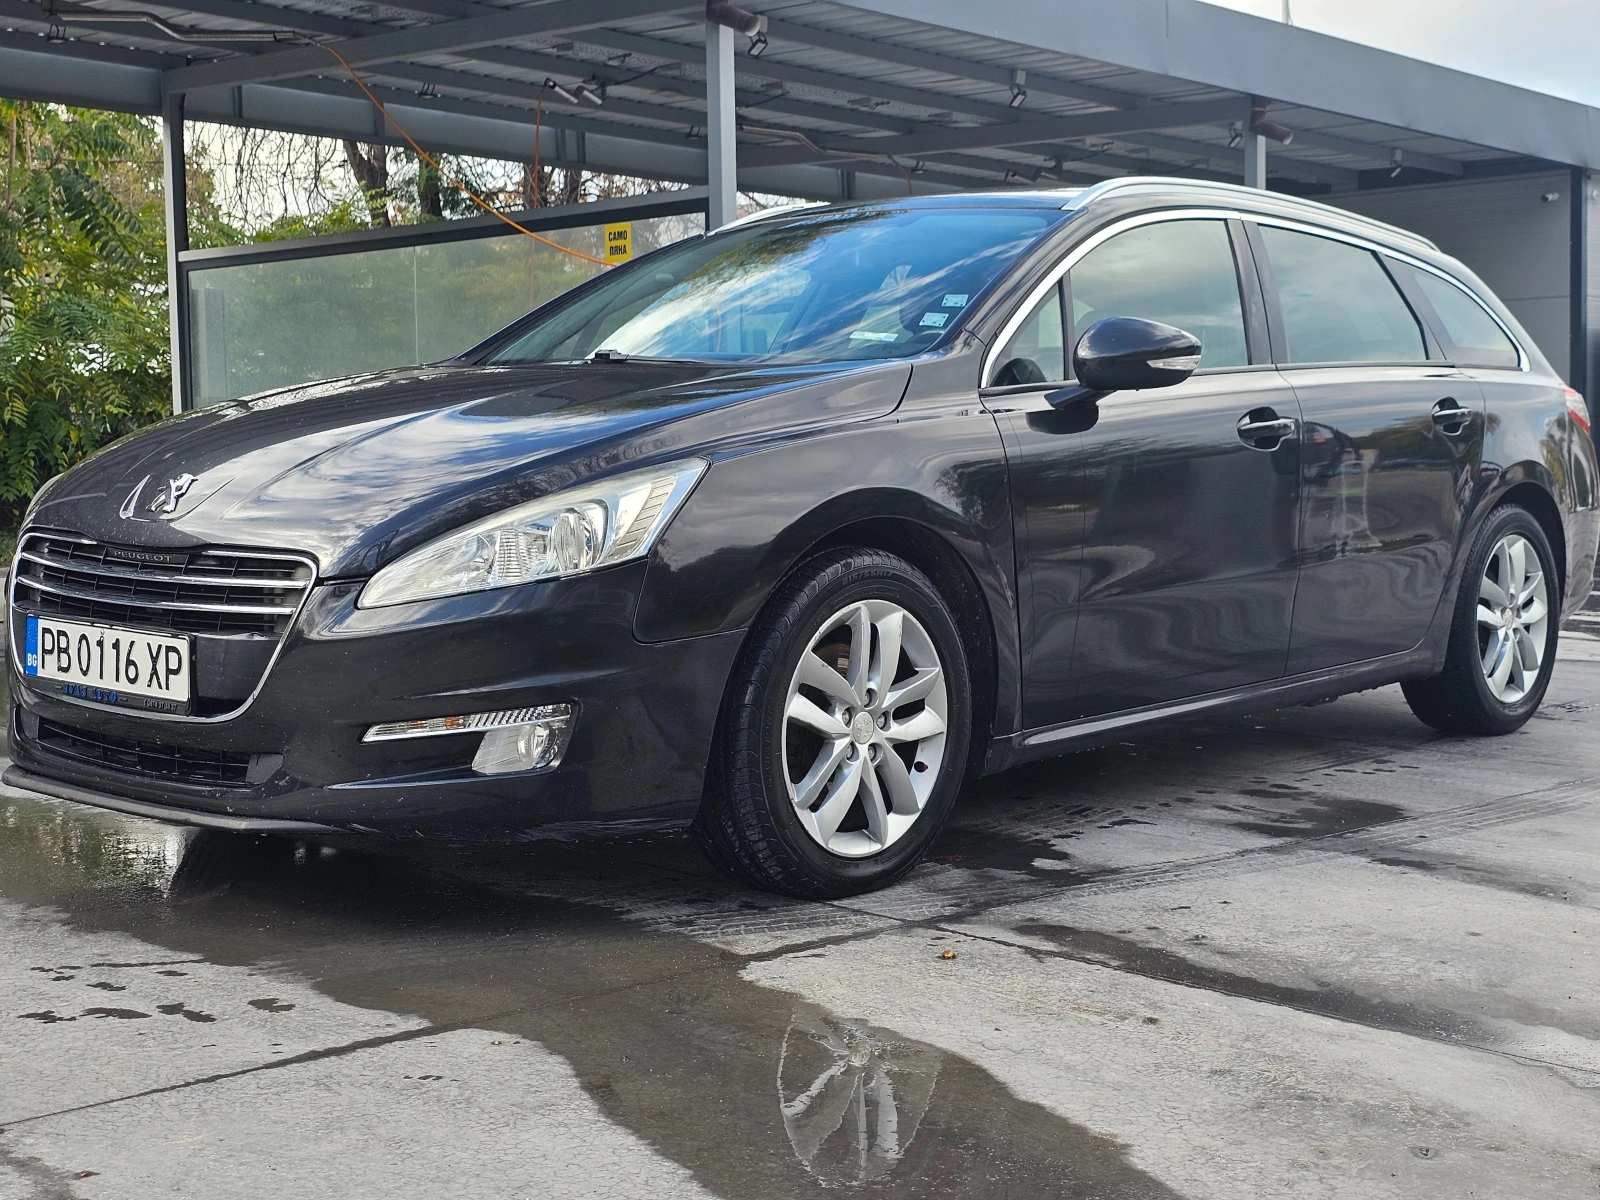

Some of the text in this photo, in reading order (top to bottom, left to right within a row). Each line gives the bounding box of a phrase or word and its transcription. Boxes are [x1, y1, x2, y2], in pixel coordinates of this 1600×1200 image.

[608, 230, 628, 242] САМО
[114, 550, 172, 563] PEUGEOT
[27, 653, 38, 667] BG
[41, 627, 183, 691] PB 0116 XP
[91, 687, 118, 703] AUTO
